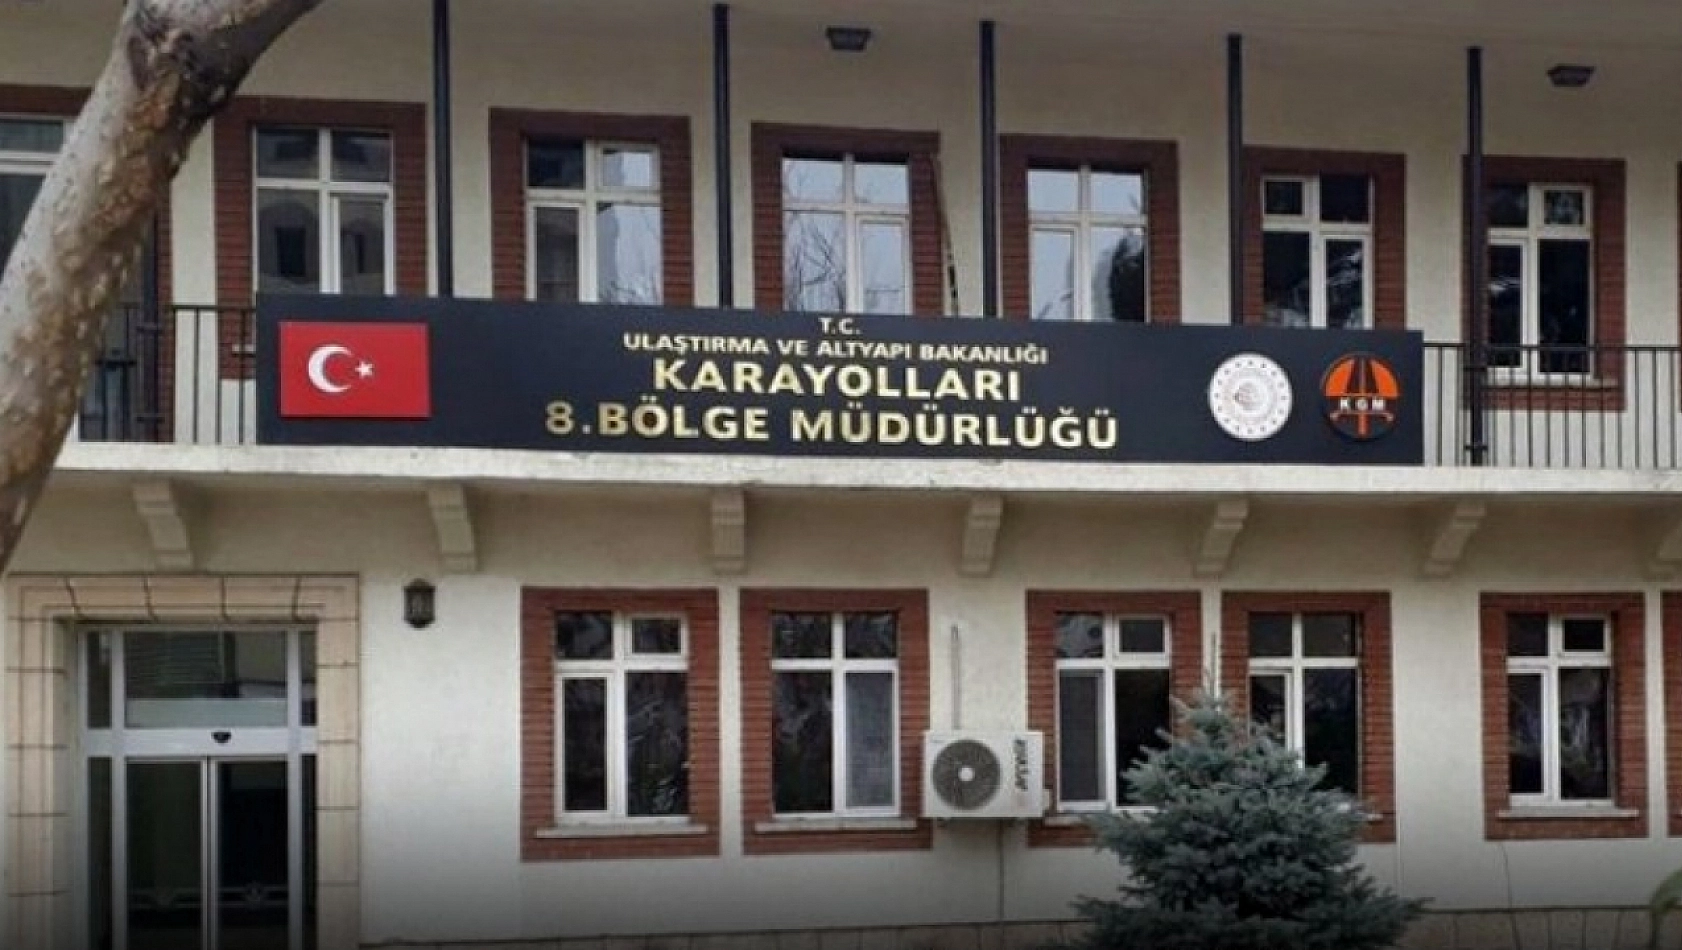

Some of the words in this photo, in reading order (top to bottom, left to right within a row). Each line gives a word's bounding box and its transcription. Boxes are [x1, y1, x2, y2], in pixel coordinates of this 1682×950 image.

[818, 317, 861, 335] T.C.
[623, 332, 770, 356] ULAŞTIRMA
[776, 338, 809, 356] VE
[817, 340, 911, 359] ALTYAPI
[919, 342, 1050, 365] BAKANLIĞI
[653, 357, 1021, 402] KARAYOLLARI
[790, 401, 1117, 448] MÜDÜRLÜĞÜ
